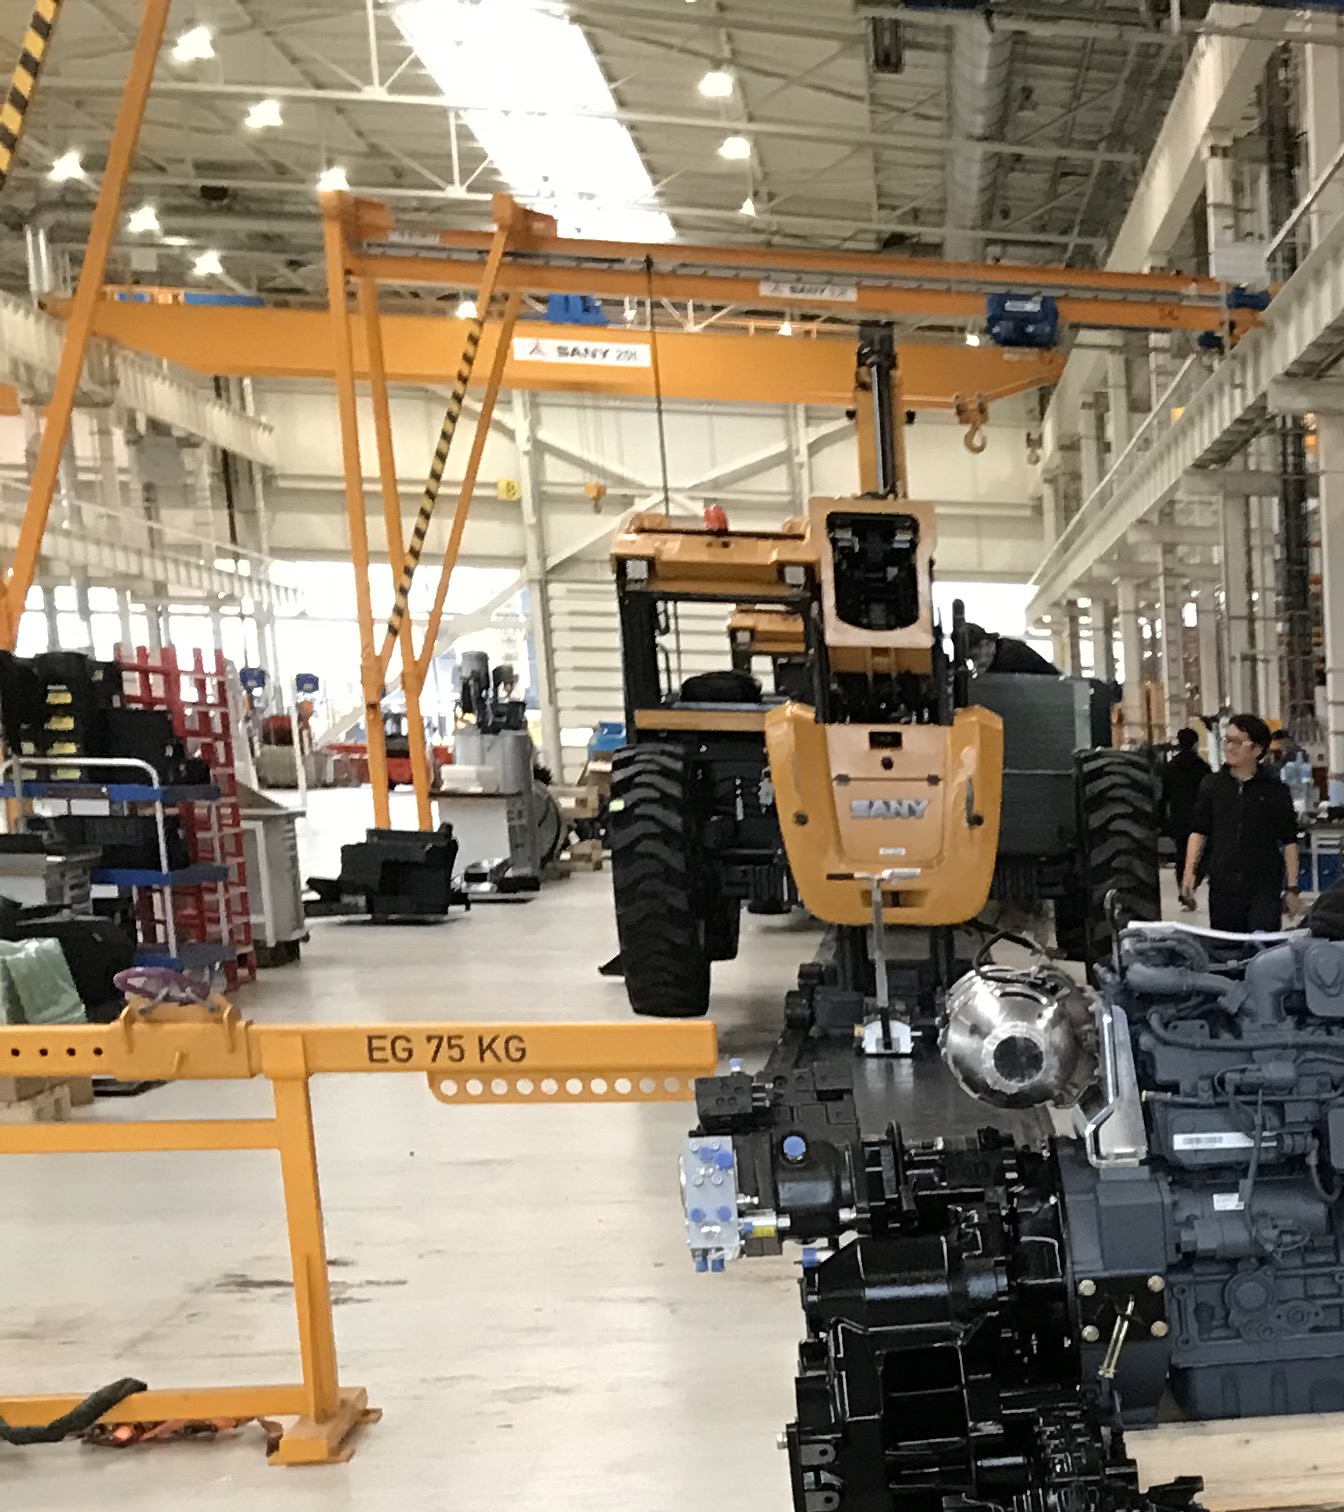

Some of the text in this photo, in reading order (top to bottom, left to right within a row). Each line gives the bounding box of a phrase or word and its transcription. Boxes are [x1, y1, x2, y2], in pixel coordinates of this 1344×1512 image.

[849, 799, 929, 820] SANY
[367, 1035, 527, 1063] EG 75 KG
